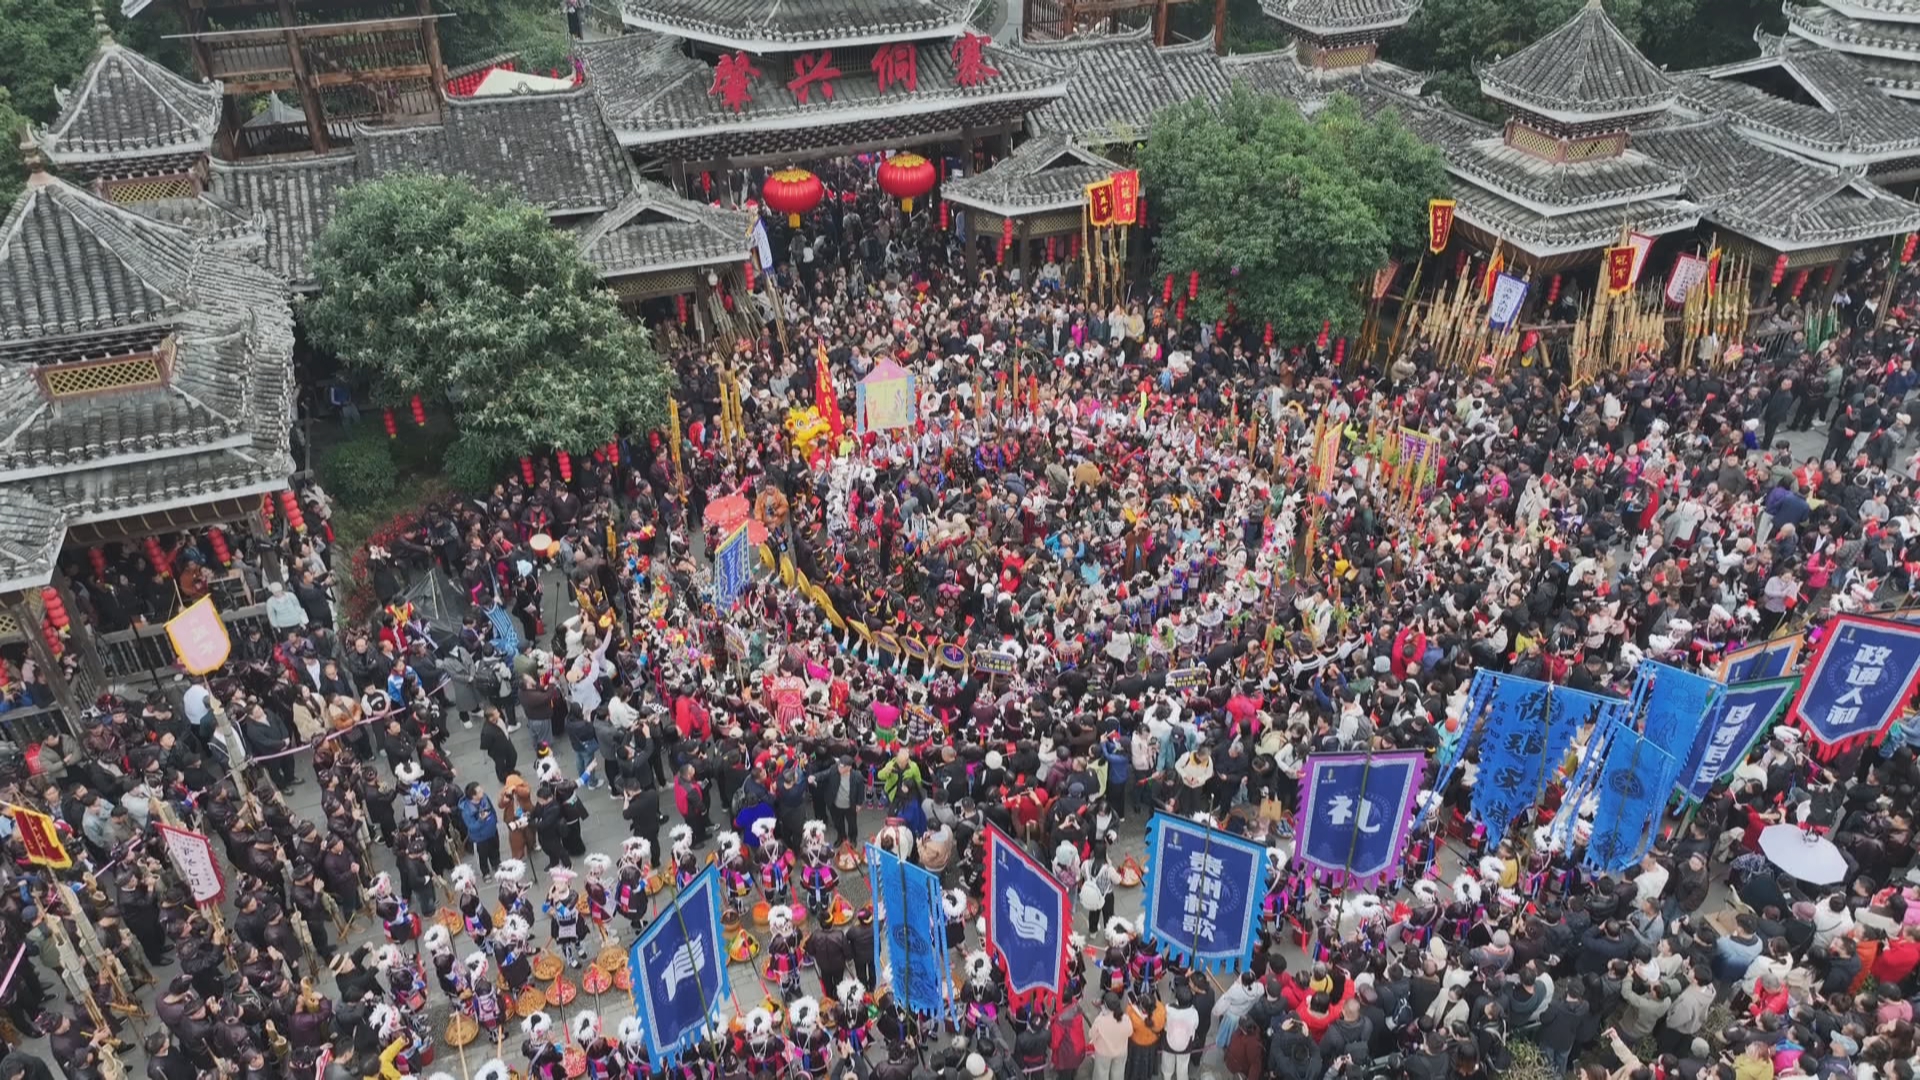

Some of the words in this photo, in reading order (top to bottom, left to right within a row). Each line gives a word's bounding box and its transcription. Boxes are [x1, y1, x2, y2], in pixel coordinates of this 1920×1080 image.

[1826, 643, 1892, 725] 政通人和
[1328, 795, 1381, 834] 礼
[1181, 850, 1225, 943] 贵州村歌
